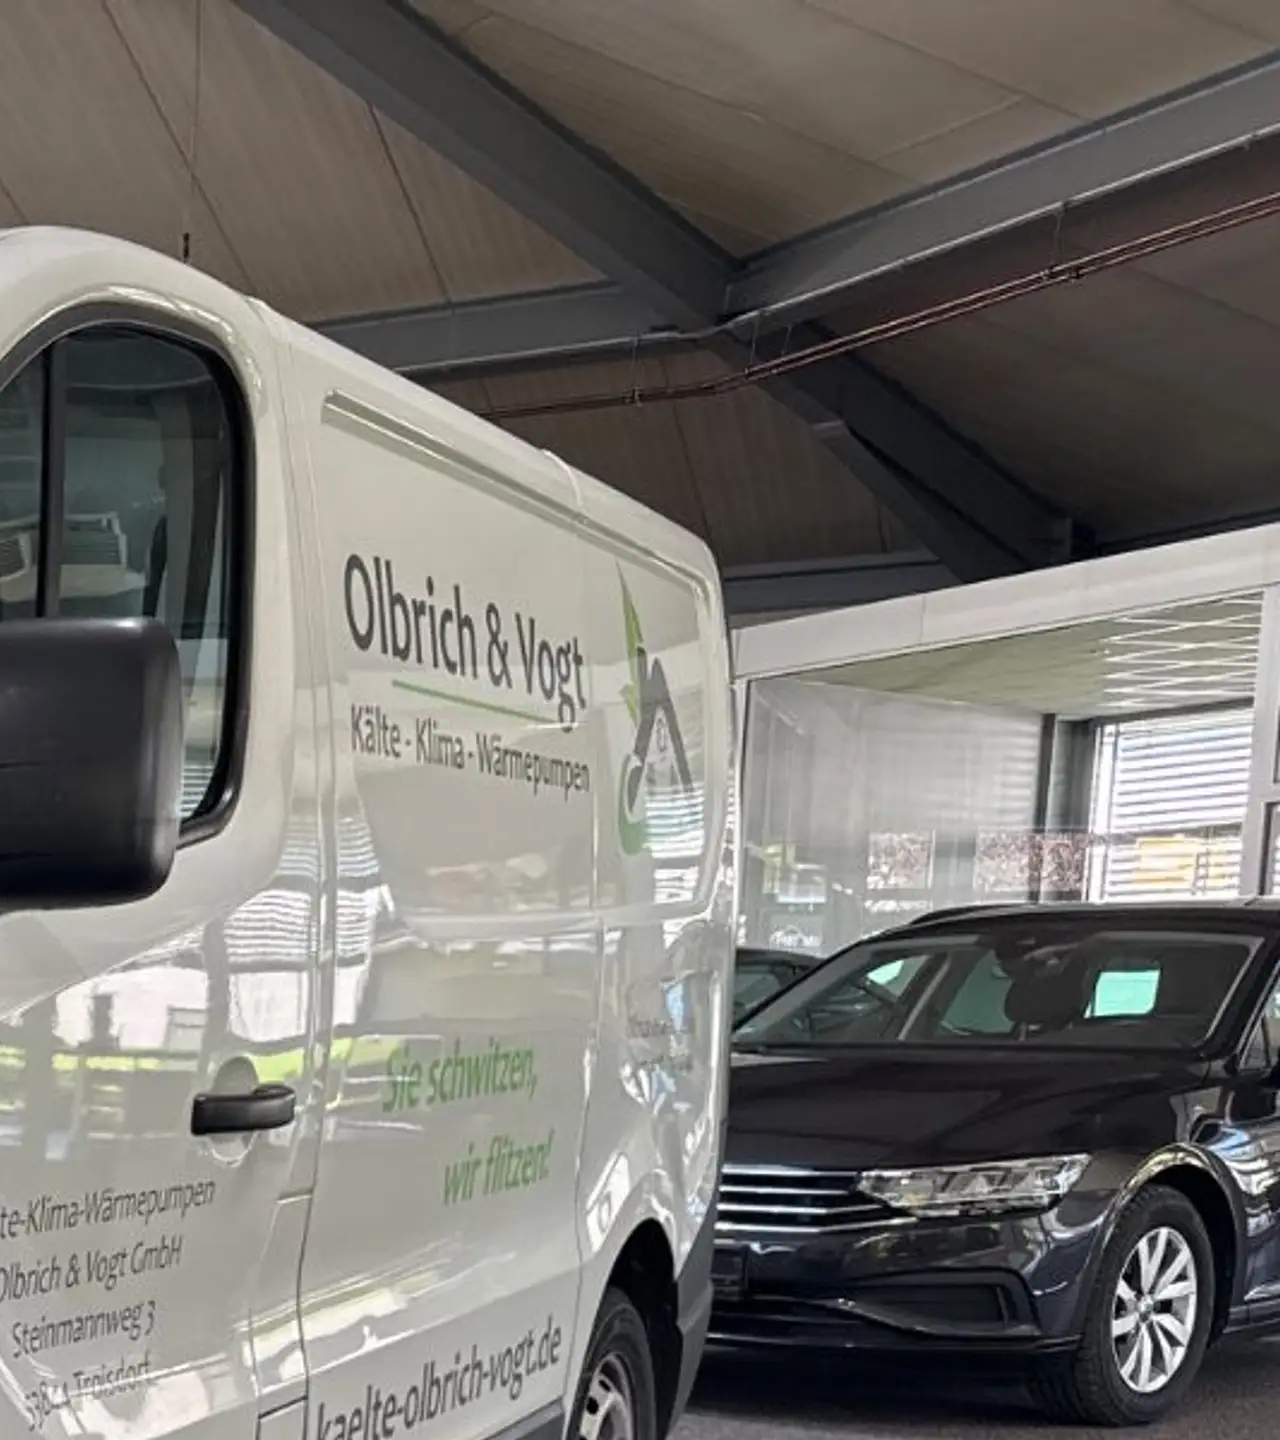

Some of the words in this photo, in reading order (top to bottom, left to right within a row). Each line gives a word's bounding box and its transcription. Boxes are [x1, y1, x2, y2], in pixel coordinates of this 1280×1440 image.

[344, 553, 477, 680] Olbrich
[485, 602, 513, 689] &
[514, 612, 587, 733] Vogt
[350, 704, 401, 758] Kälte
[415, 717, 465, 770] Klima
[476, 732, 590, 802] Wärmepumpen
[382, 1044, 423, 1114] Sie
[426, 1036, 538, 1102] schwitzen,
[443, 1141, 483, 1206] wir
[483, 1125, 556, 1196] flitzen!
[65, 1252, 81, 1289] &
[86, 1247, 127, 1292] Vogt
[129, 1234, 184, 1276] GmbH
[12, 1300, 144, 1359] Steinmannweg
[144, 1299, 156, 1336] 3
